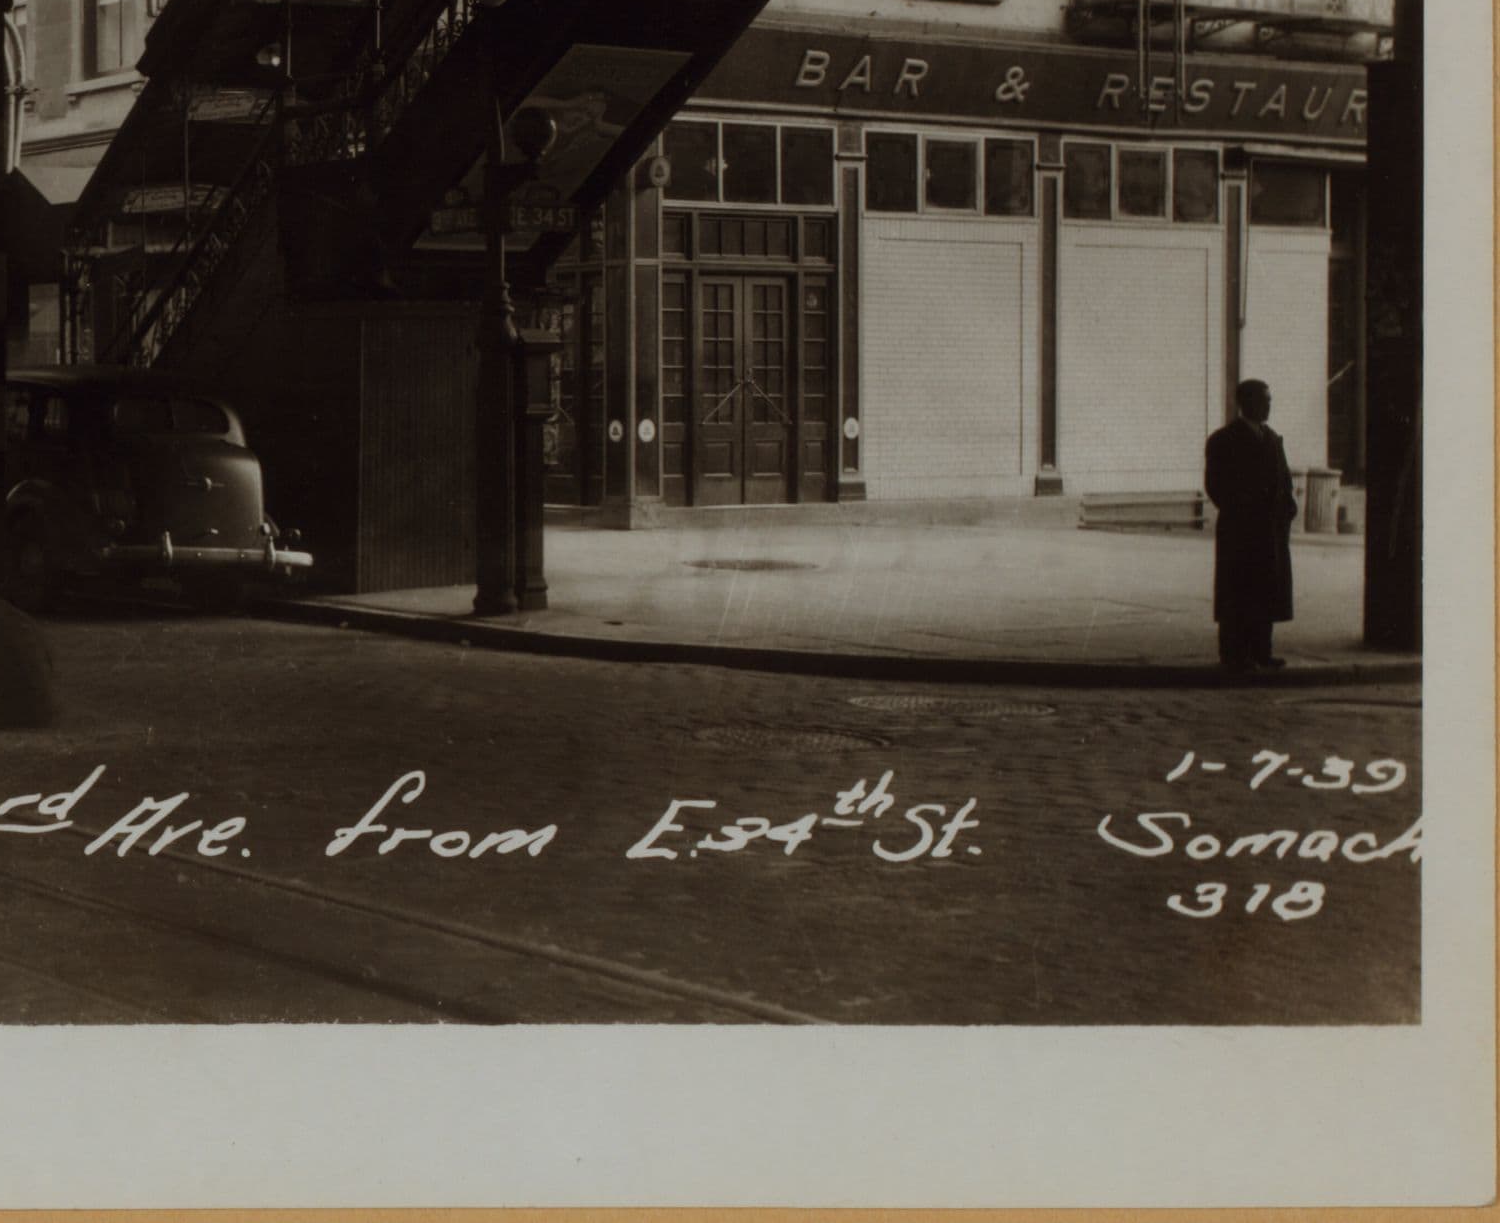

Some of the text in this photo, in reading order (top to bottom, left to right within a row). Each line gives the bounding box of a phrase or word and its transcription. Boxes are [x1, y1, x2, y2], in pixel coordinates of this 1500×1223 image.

[796, 49, 1368, 124] BAR & RESTAUR
[533, 207, 554, 225] 34
[557, 207, 576, 225] ST
